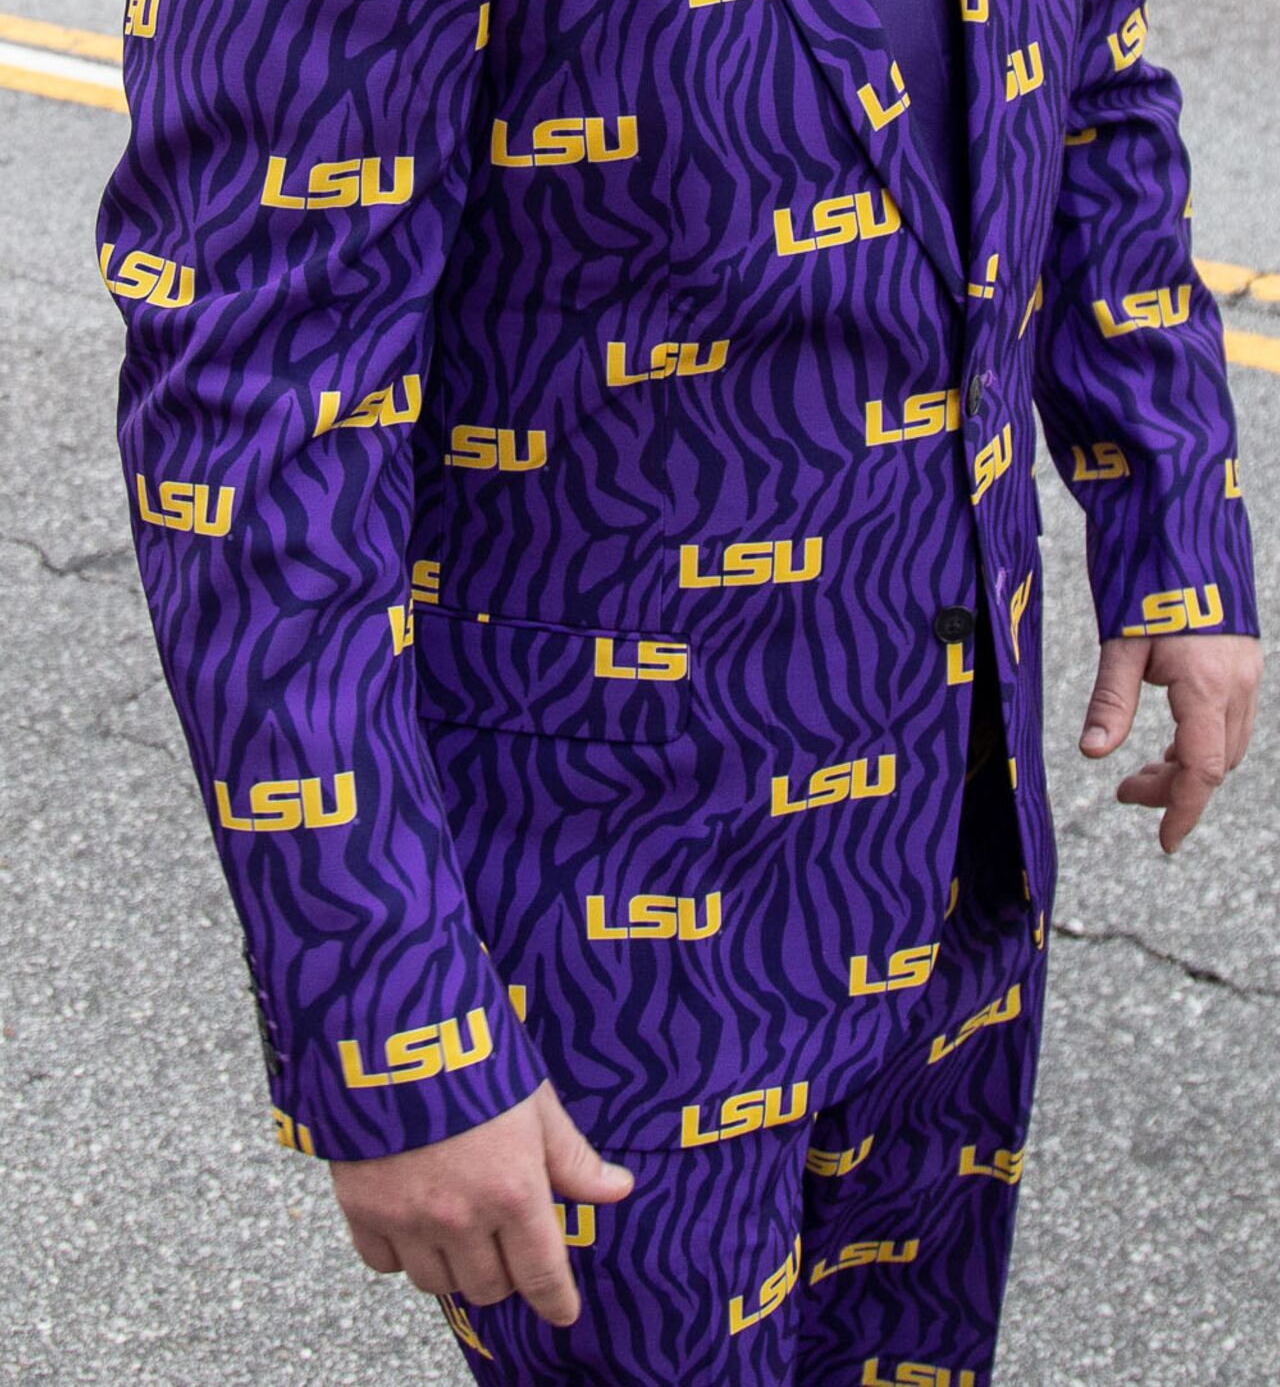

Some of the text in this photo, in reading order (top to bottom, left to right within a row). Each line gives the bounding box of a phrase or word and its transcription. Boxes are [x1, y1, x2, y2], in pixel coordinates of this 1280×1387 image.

[1106, 2, 1149, 73] LS
[491, 115, 638, 167] LSU
[261, 155, 414, 210] LSU
[773, 189, 902, 256] LSU
[1092, 284, 1191, 339] LSU
[606, 339, 730, 387] LSU
[313, 374, 422, 437] LSU
[444, 423, 548, 472] SU
[970, 422, 1013, 506] SU
[1072, 442, 1131, 482] LS
[136, 473, 236, 538] LSU
[679, 536, 823, 589] LSU
[594, 636, 690, 682] LS
[214, 771, 357, 832] LSU
[771, 753, 897, 818] LSU
[586, 891, 722, 941] LSU
[337, 1006, 494, 1089] LSU
[928, 983, 1022, 1065] LSU
[680, 1080, 809, 1149] LSU
[806, 1134, 875, 1177] SU
[958, 1145, 1024, 1186] LS
[729, 1232, 802, 1336] LSU
[809, 1238, 920, 1286] LSU
